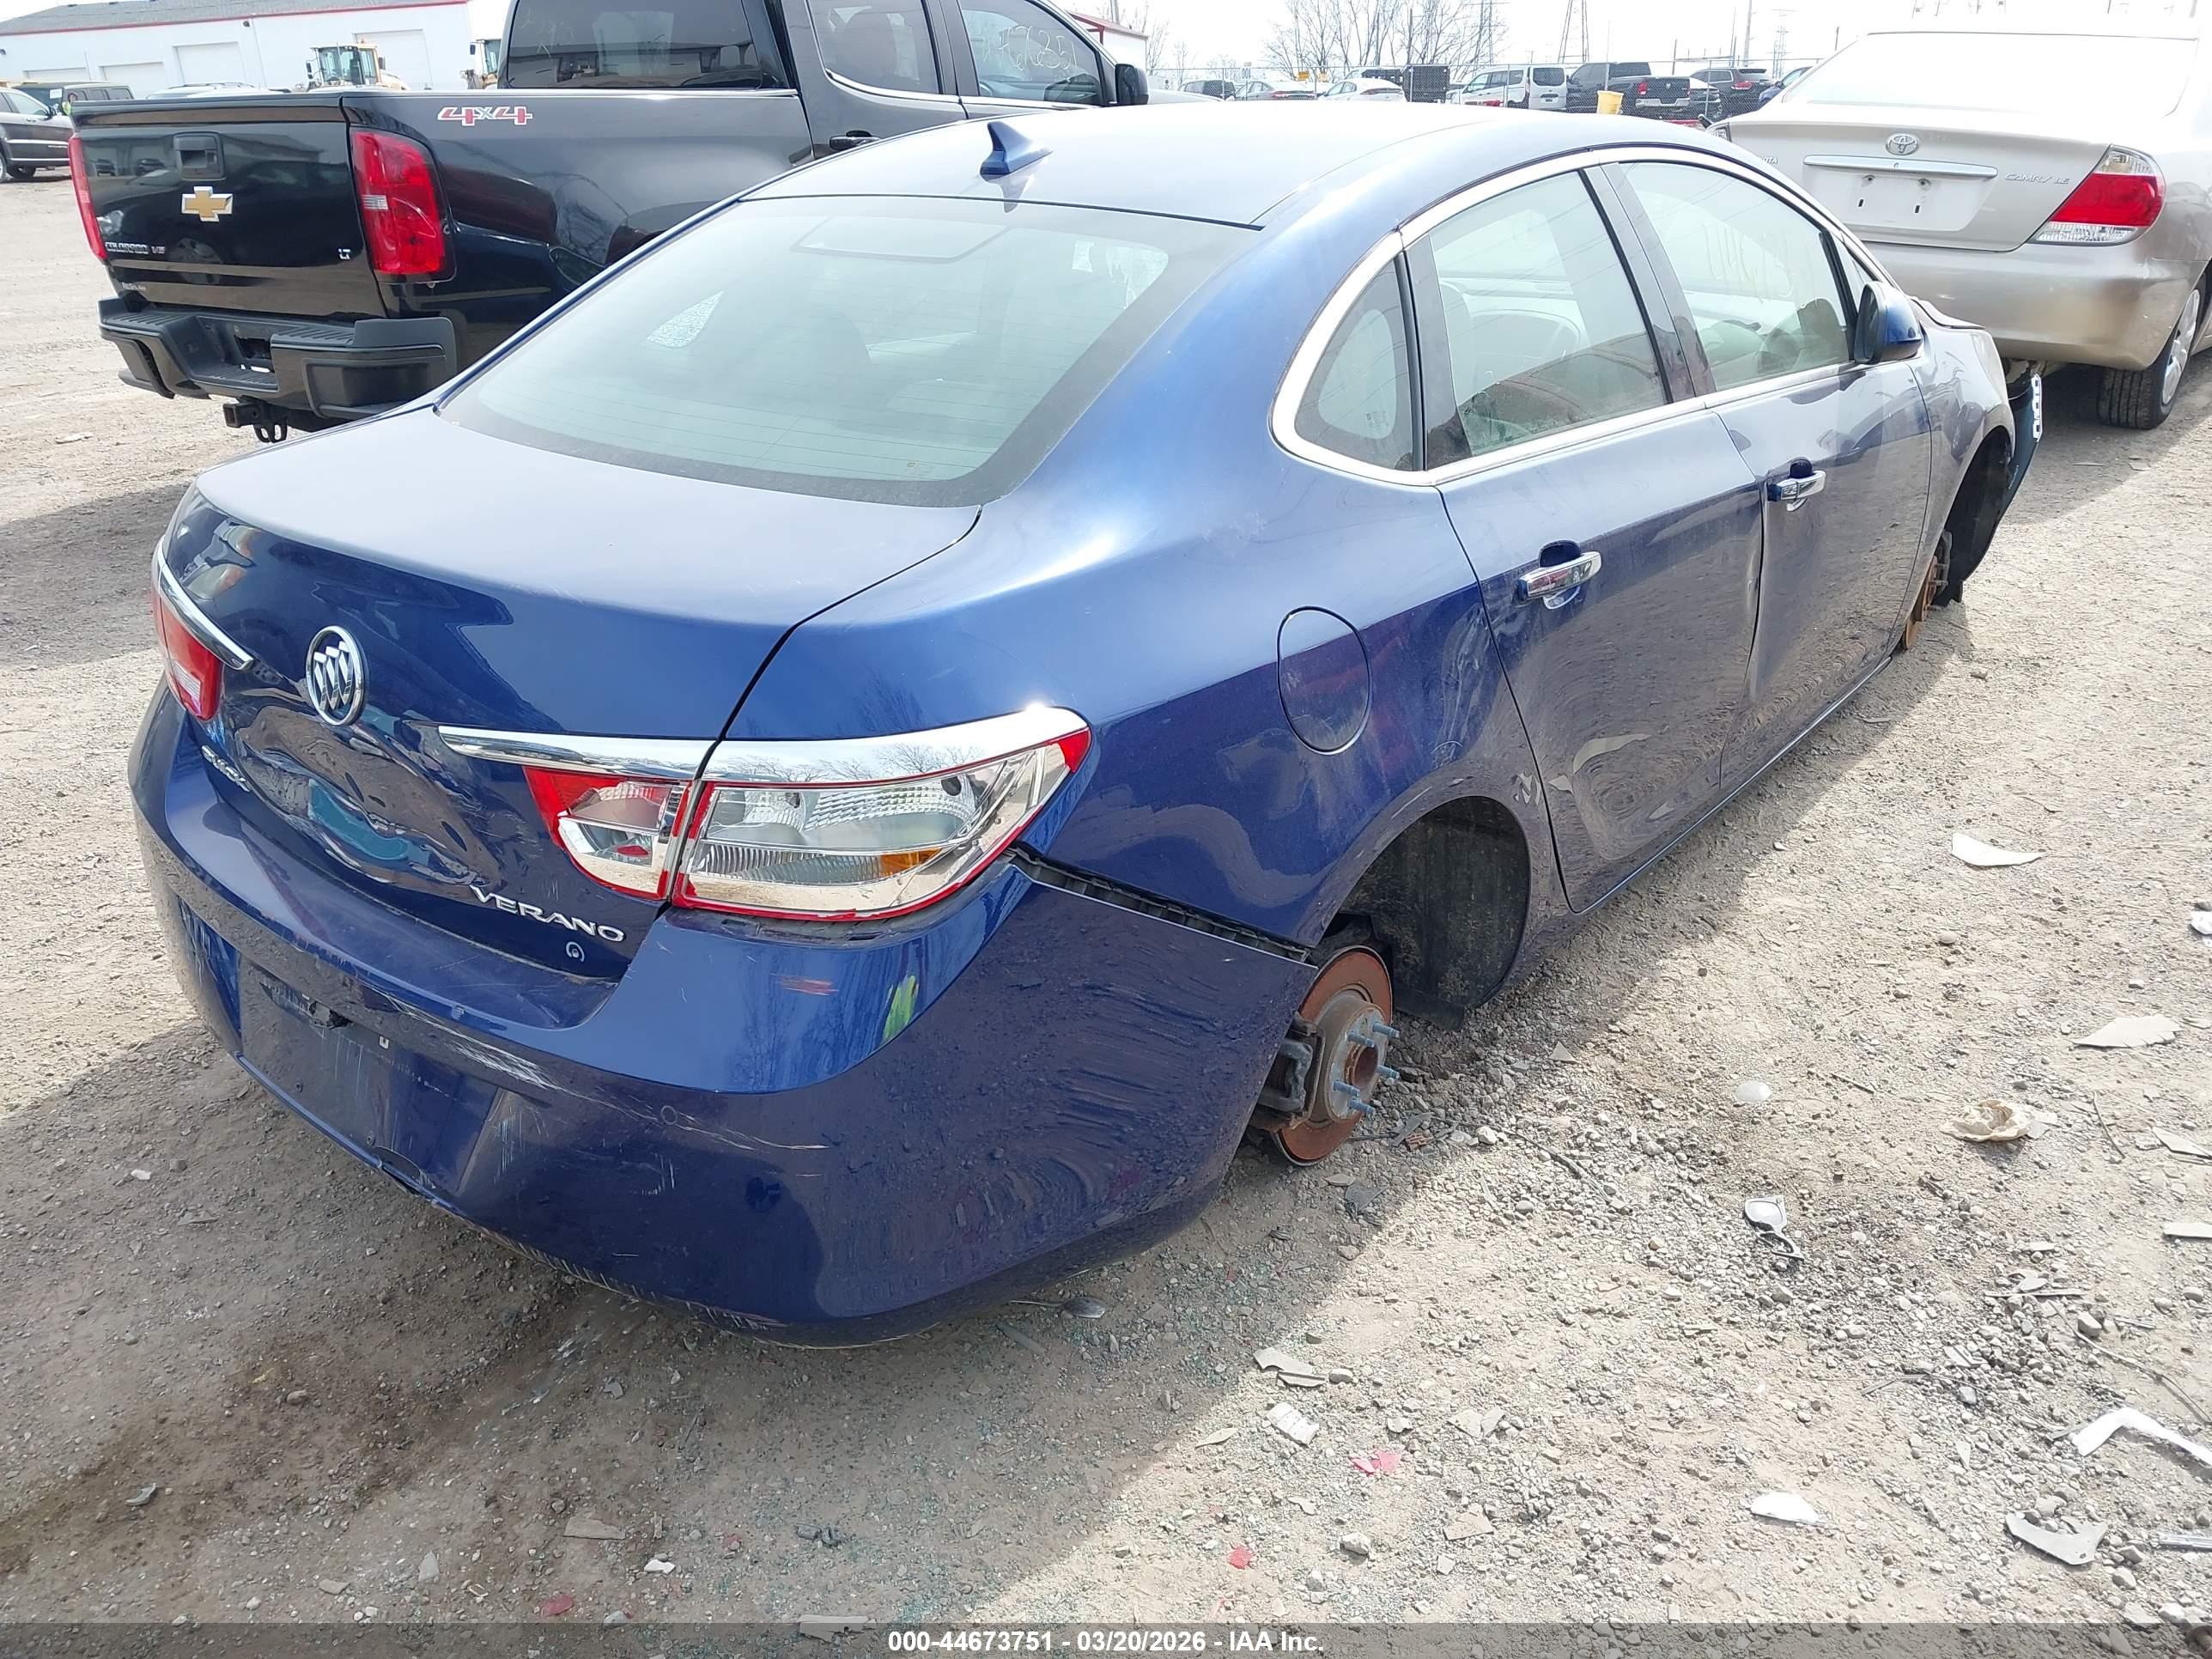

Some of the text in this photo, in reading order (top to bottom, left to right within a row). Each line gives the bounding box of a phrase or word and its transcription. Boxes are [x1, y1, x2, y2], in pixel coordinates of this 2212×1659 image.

[2006, 173, 2052, 184] CAMRY
[337, 248, 351, 260] LT
[469, 884, 625, 943] VERANO
